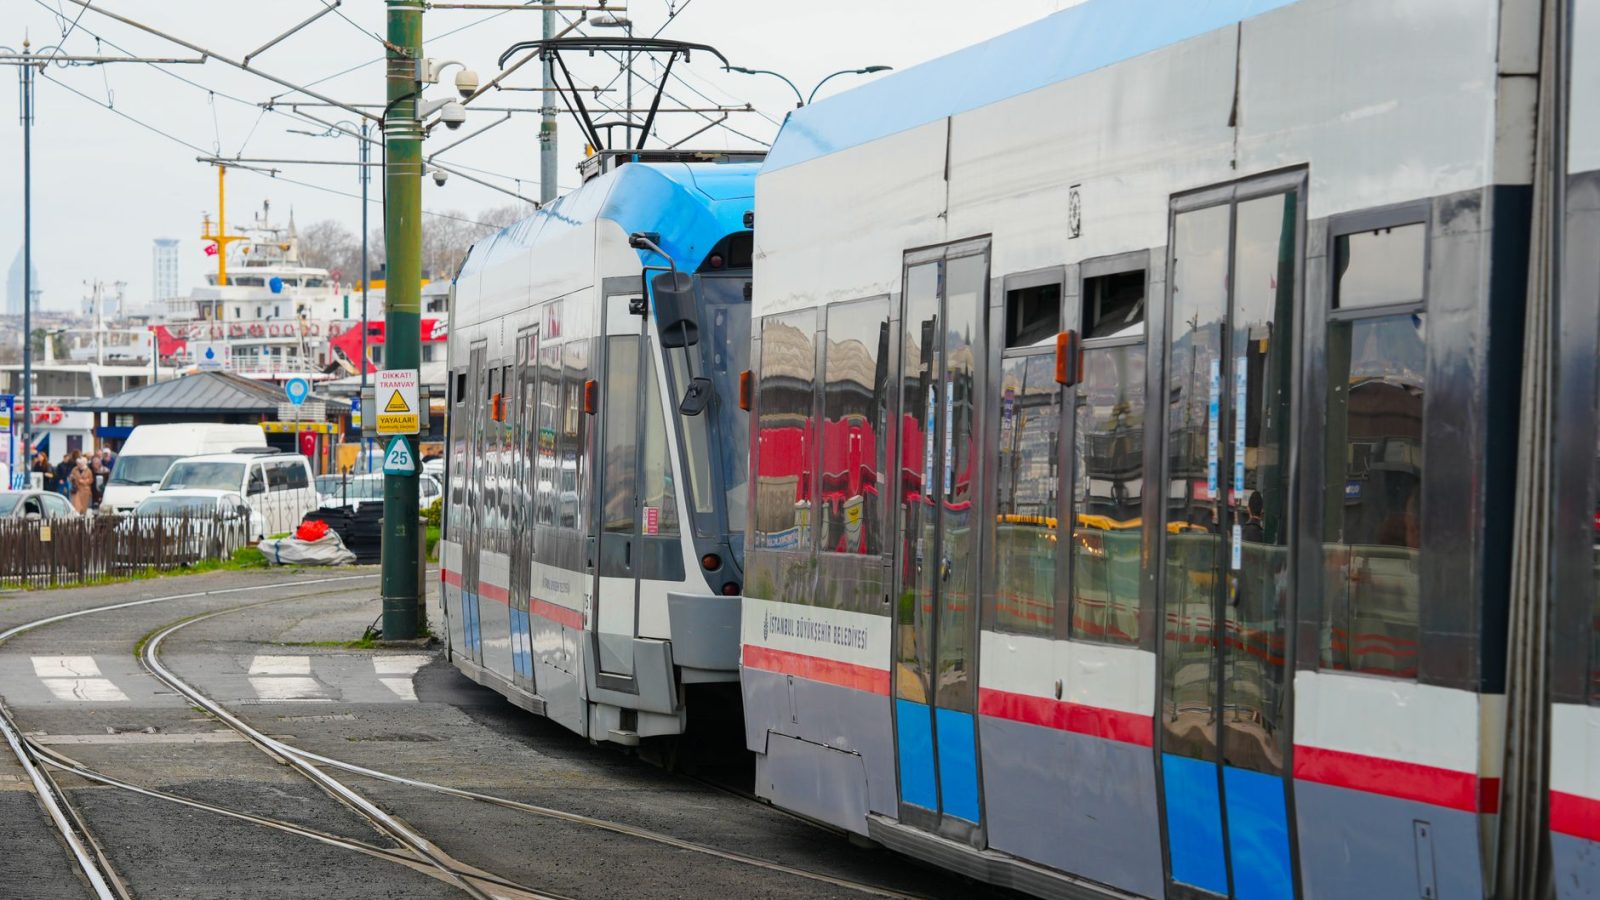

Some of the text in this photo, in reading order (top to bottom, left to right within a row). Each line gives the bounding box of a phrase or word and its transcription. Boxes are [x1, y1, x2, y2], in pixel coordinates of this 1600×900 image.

[391, 450, 408, 465] 25
[769, 612, 868, 650] İSTANBUL BÜYÜKŞEHİR BELEDİYESİ
